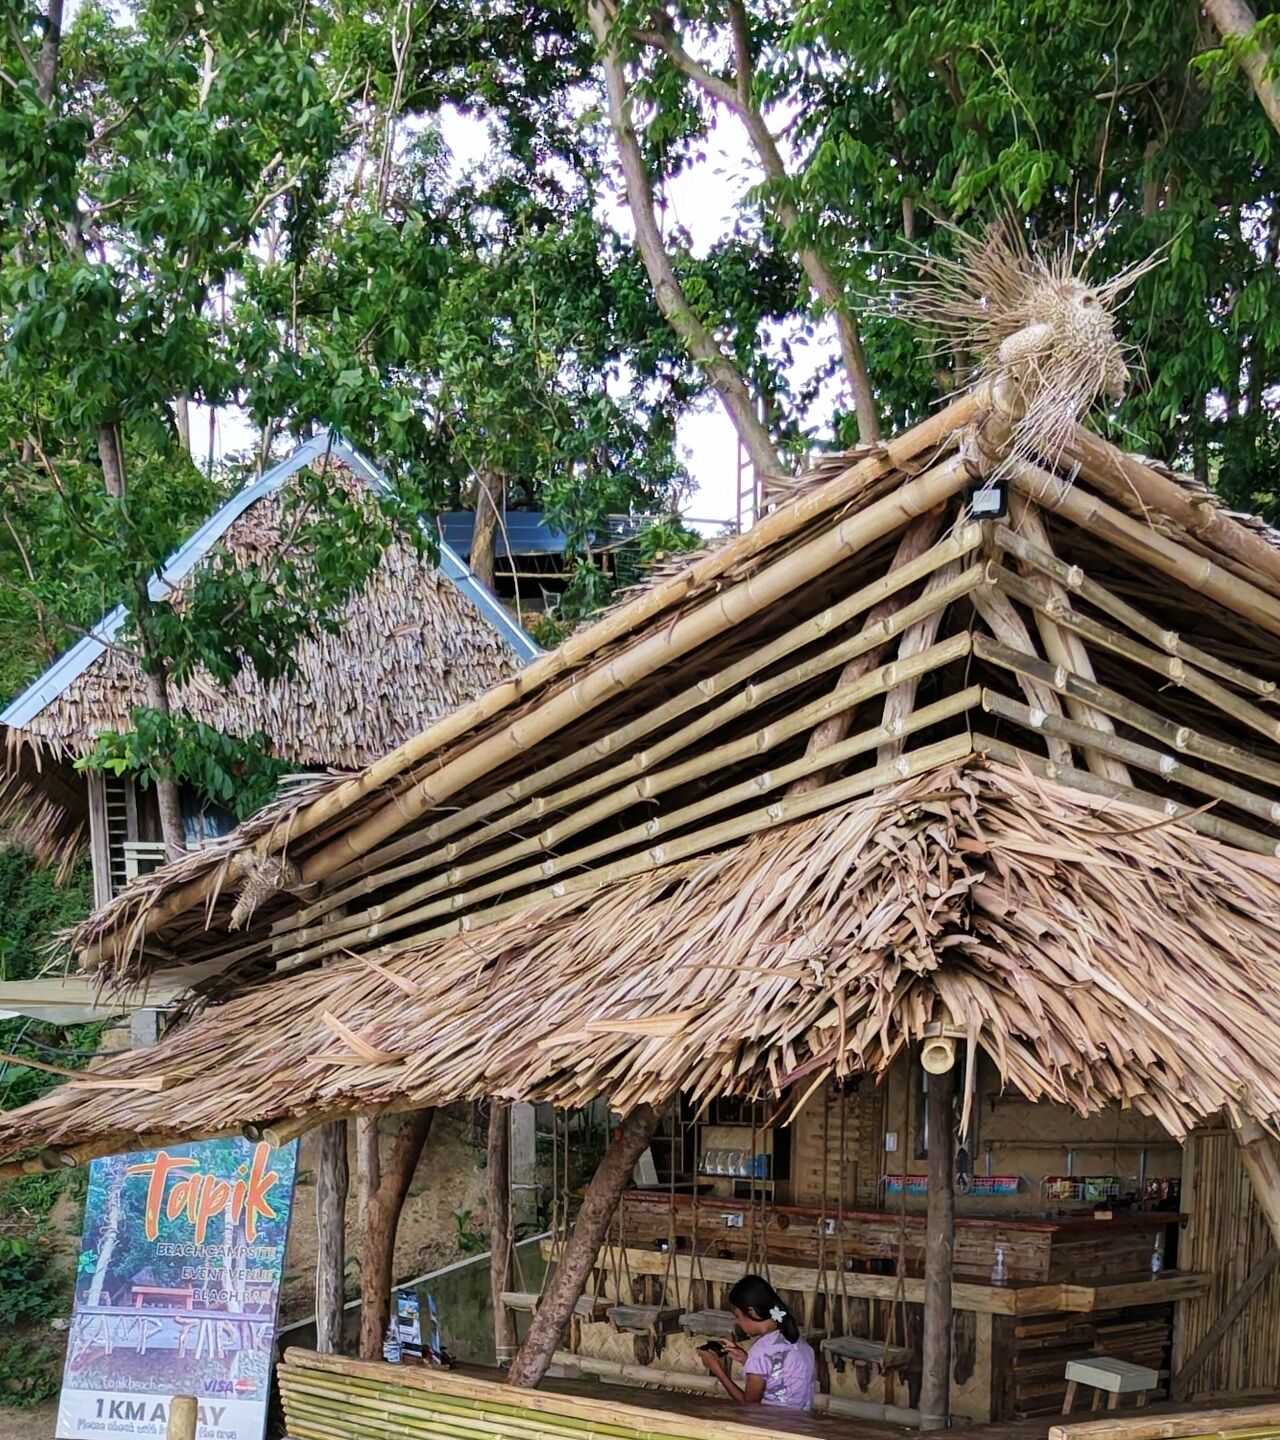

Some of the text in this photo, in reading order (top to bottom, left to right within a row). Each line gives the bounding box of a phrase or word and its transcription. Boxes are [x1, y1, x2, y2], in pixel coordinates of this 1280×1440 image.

[126, 1142, 278, 1244] Tapik
[156, 1243, 203, 1257] BEACH
[181, 1266, 223, 1280] EVENT
[192, 1289, 239, 1303] BEACH
[204, 1379, 234, 1393] VISA
[96, 1398, 226, 1427] 1 KM AAY
